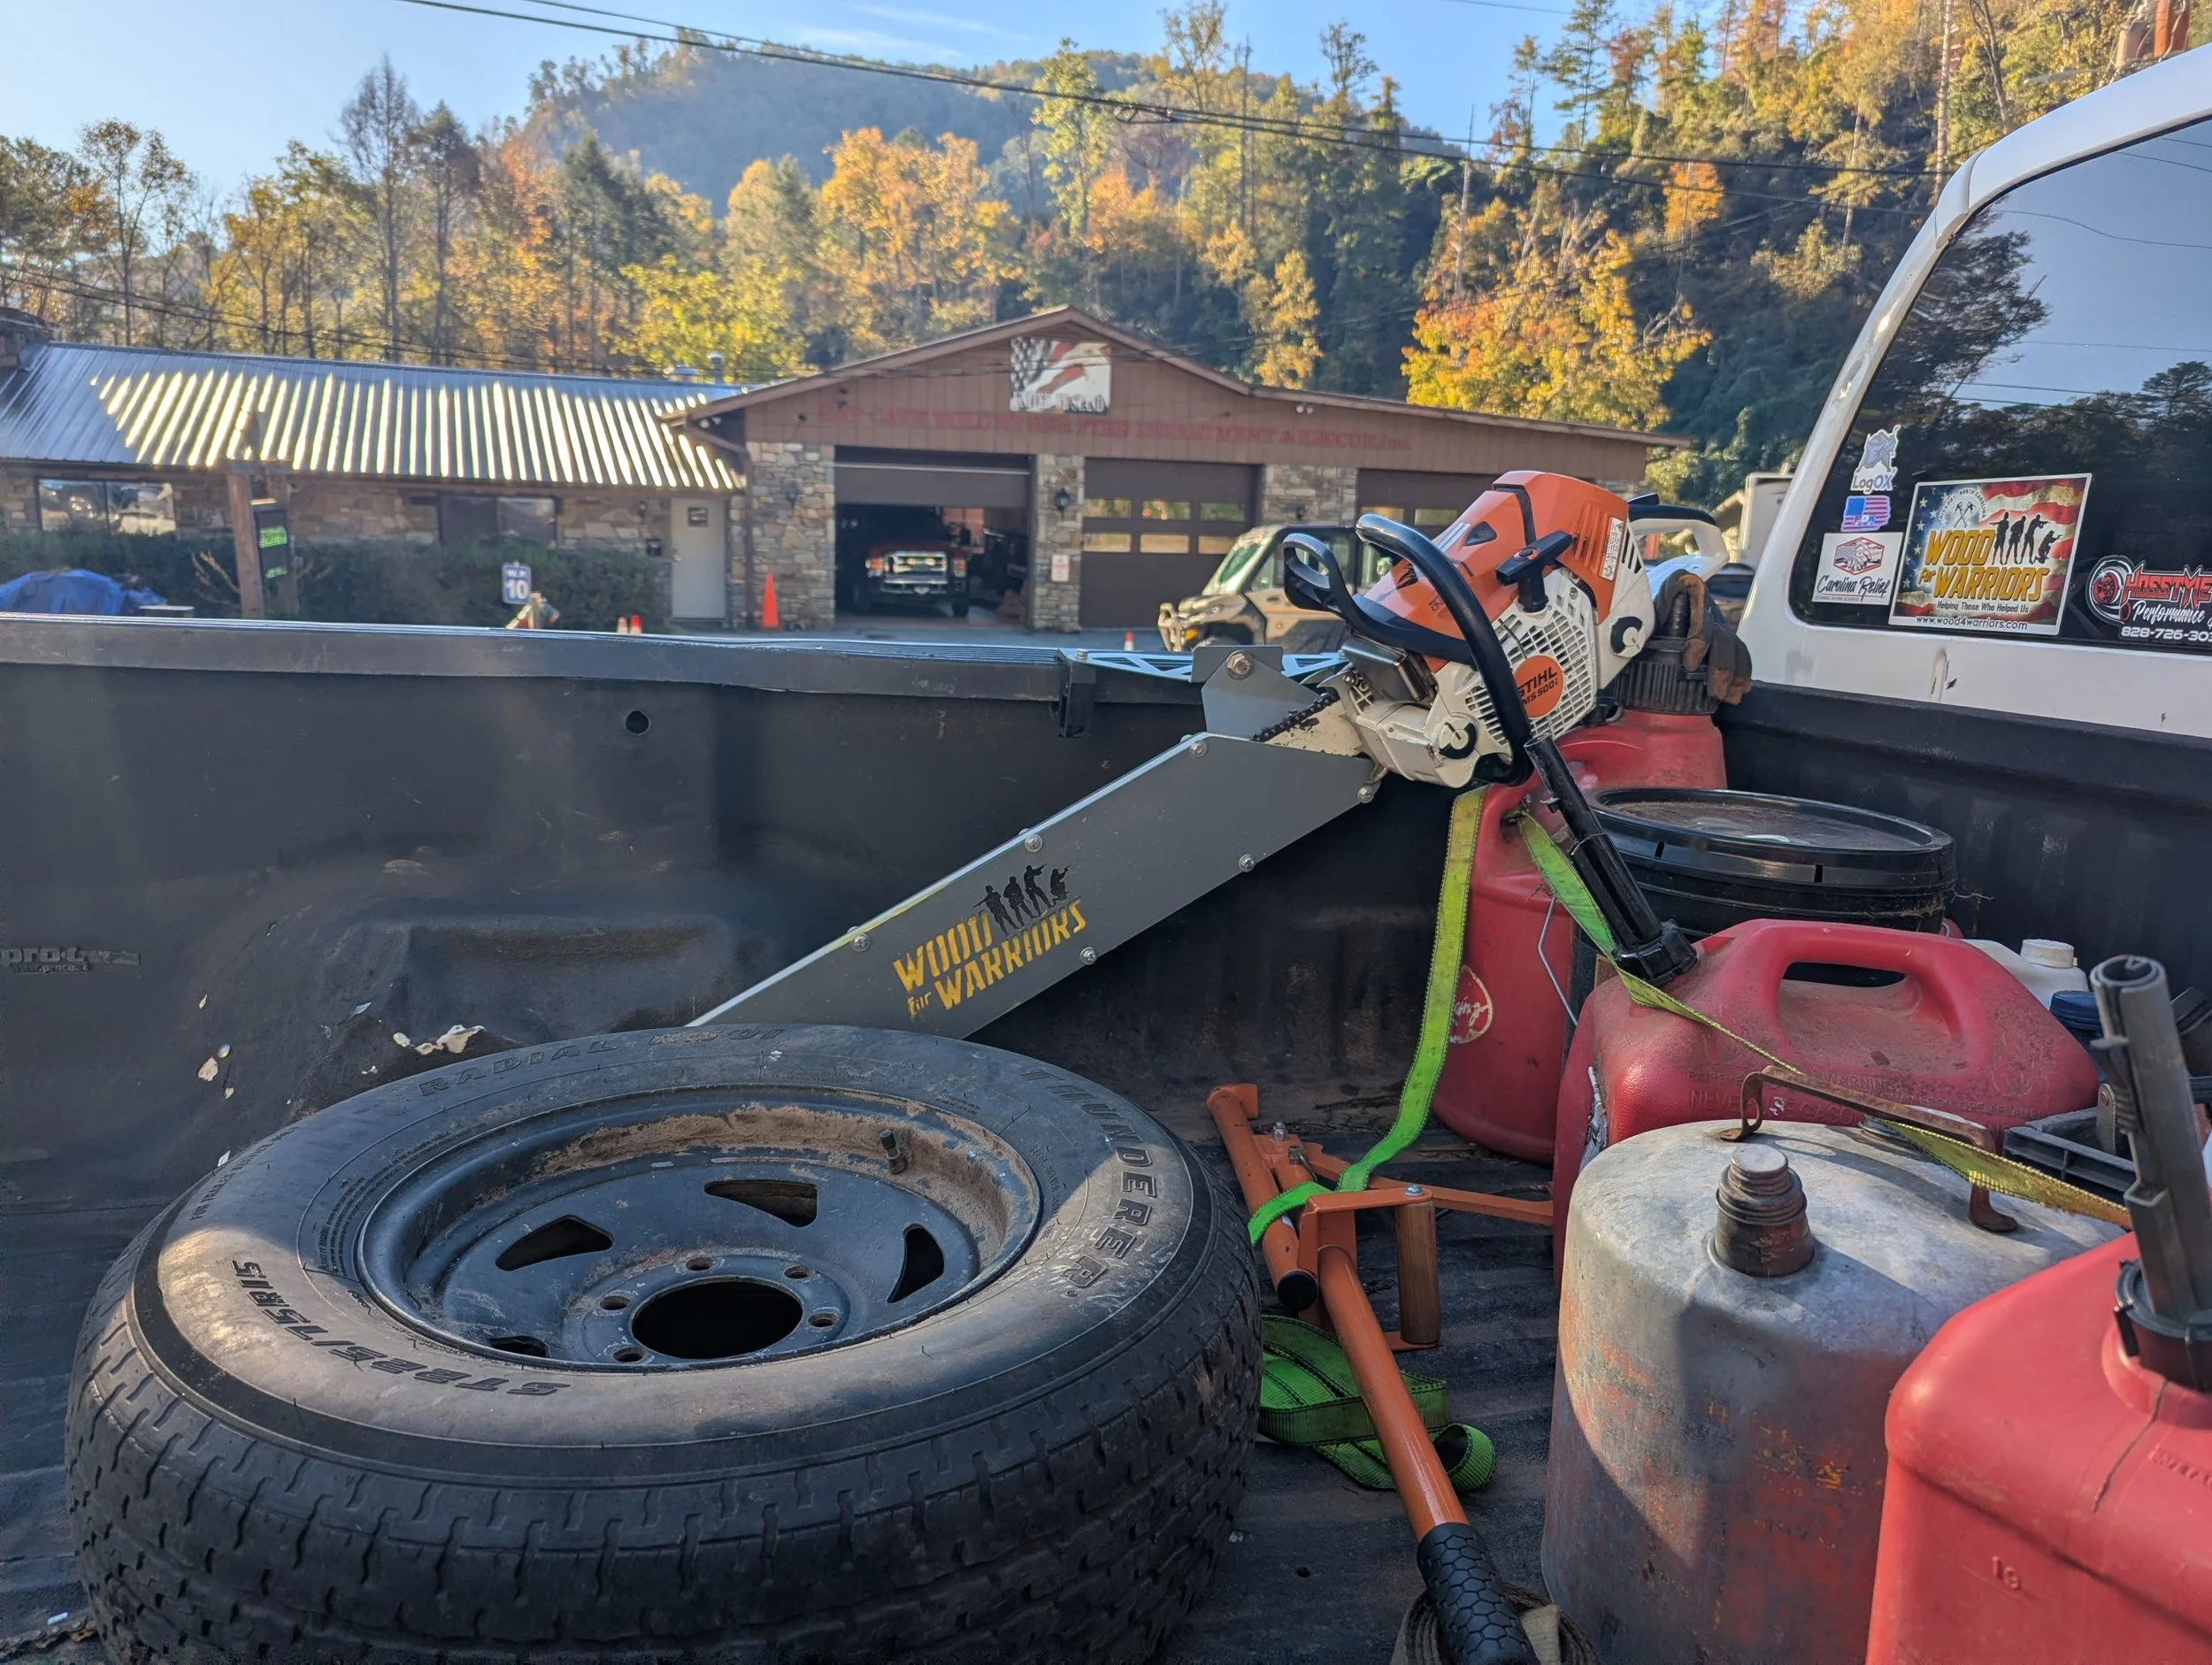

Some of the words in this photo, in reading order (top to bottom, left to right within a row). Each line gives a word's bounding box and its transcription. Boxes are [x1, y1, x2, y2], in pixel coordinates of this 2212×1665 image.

[1852, 475, 1893, 493] LogOX
[1924, 529, 1996, 566] WOOD
[506, 579, 528, 600] 10
[1817, 575, 1857, 594] Carolina
[1858, 576, 1891, 602] Relief
[1932, 566, 2050, 602] WARRIORS
[1916, 616, 2028, 631] www.wood4warriors.com
[1937, 601, 1958, 610] Helping
[1961, 602, 1979, 611] Those
[1981, 602, 1994, 611] Who
[1996, 603, 2018, 613] Helped
[2020, 604, 2029, 613] Us
[2132, 601, 2206, 625] Performance
[893, 909, 994, 992] WOOD
[933, 895, 1087, 1011] WARRIORS
[419, 1040, 619, 1097] RADIAL
[1020, 1068, 1158, 1288] THUNDERER
[231, 1260, 571, 1396] ST225/75R15
